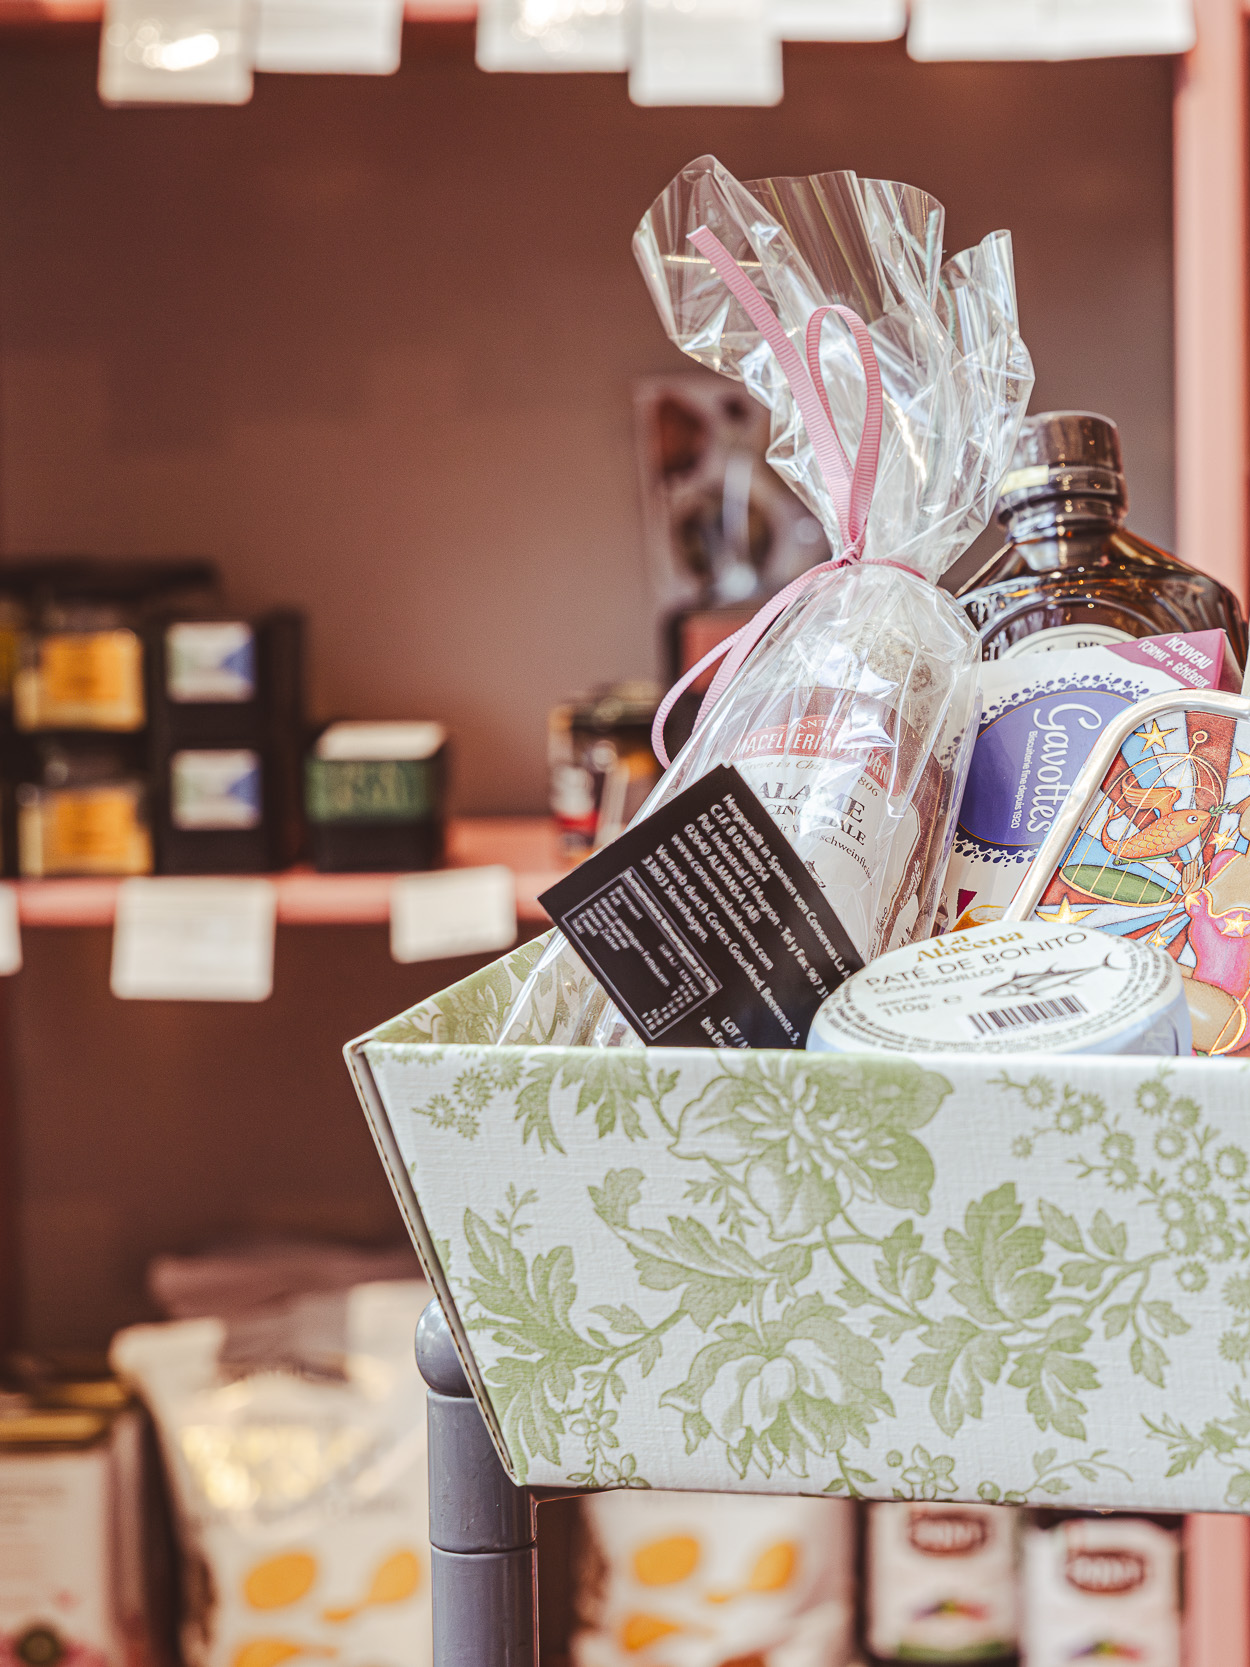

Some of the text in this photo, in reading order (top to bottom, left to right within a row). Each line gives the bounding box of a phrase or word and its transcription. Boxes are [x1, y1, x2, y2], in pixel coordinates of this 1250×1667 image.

[1137, 639, 1170, 663] FORMAT
[1164, 635, 1214, 671] NOUVEAU
[1010, 730, 1039, 829] Biscuiterie fine depuis 1920
[1027, 703, 1103, 833] Gavottes
[726, 826, 737, 836] B
[656, 845, 687, 885] Vertrieb
[684, 885, 708, 913] durch
[706, 912, 731, 944] Cortes
[697, 814, 715, 834] Pol.
[711, 832, 749, 878] Industrial
[781, 927, 795, 945] Tel
[788, 943, 798, 951] y
[707, 855, 746, 903] ALMANSA
[742, 902, 761, 923] (AB)
[723, 794, 764, 847] Hergestellt
[761, 846, 770, 858] in
[768, 856, 797, 895] Spanien
[794, 894, 809, 914] von
[806, 912, 838, 959] Conservas
[834, 957, 844, 971] La
[664, 885, 707, 943] Steinhagen.
[865, 931, 1087, 986] PATÉ DE BONITO
[700, 1016, 716, 1036] bis
[720, 1016, 741, 1038] LOT
